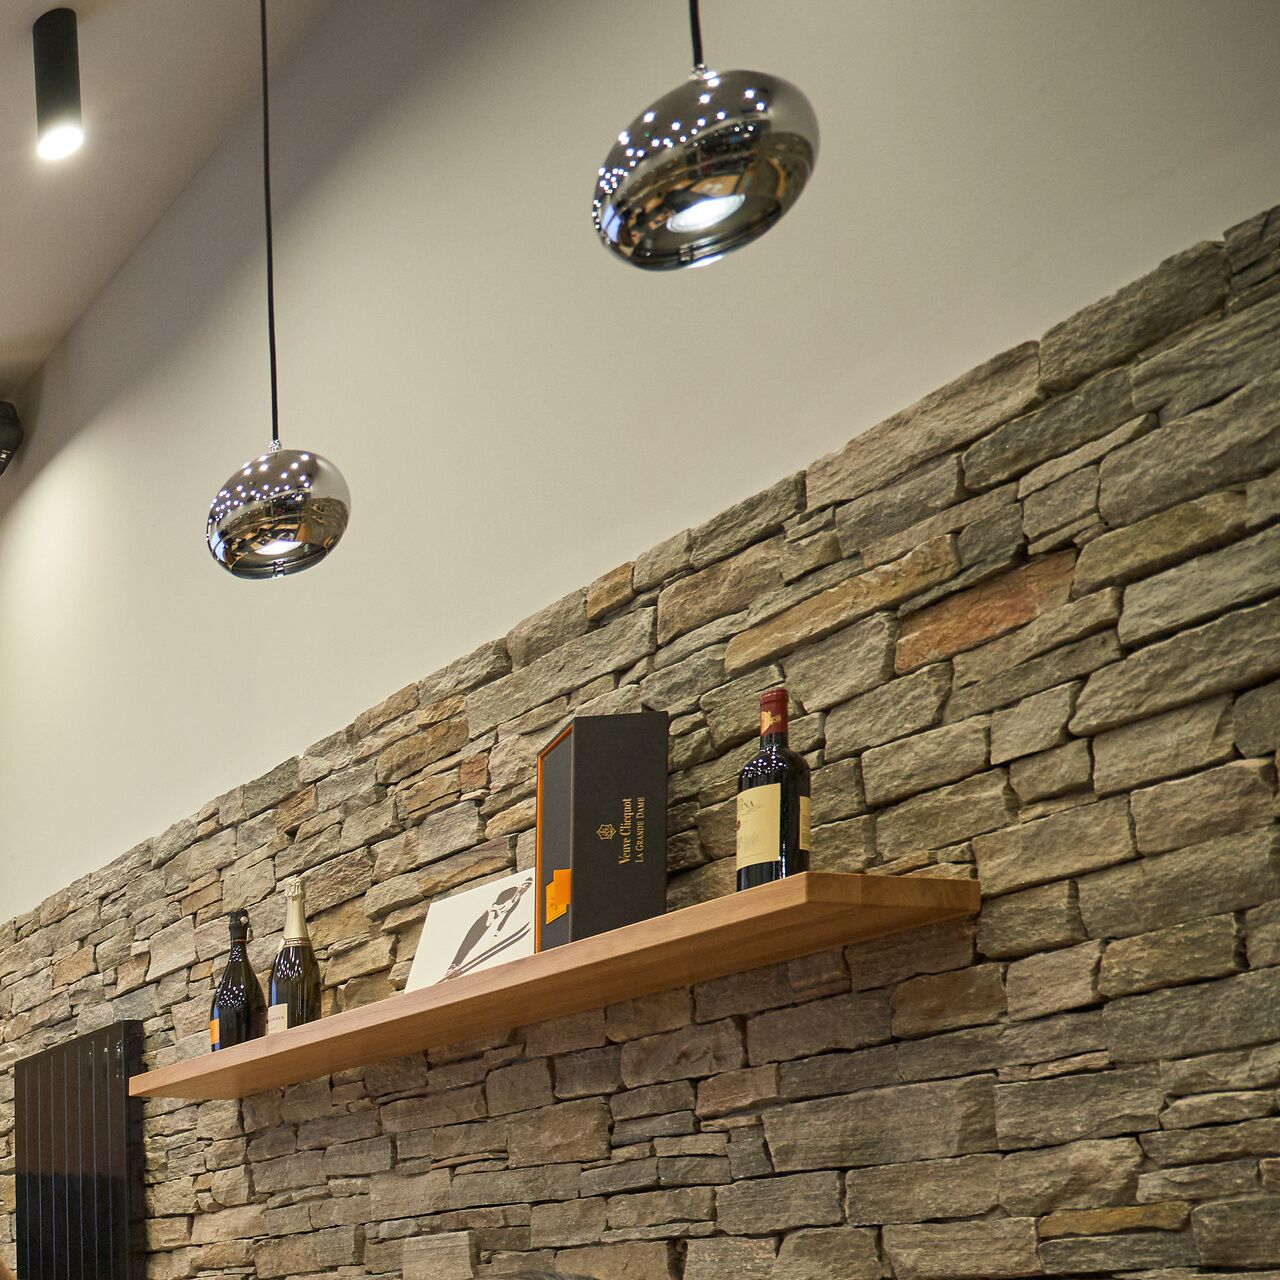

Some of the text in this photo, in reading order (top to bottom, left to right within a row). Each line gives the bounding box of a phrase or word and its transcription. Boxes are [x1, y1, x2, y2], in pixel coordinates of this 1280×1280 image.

[635, 796, 646, 819] DAME
[618, 798, 634, 865] Veuve Clicquot
[635, 820, 645, 851] GRANDE
